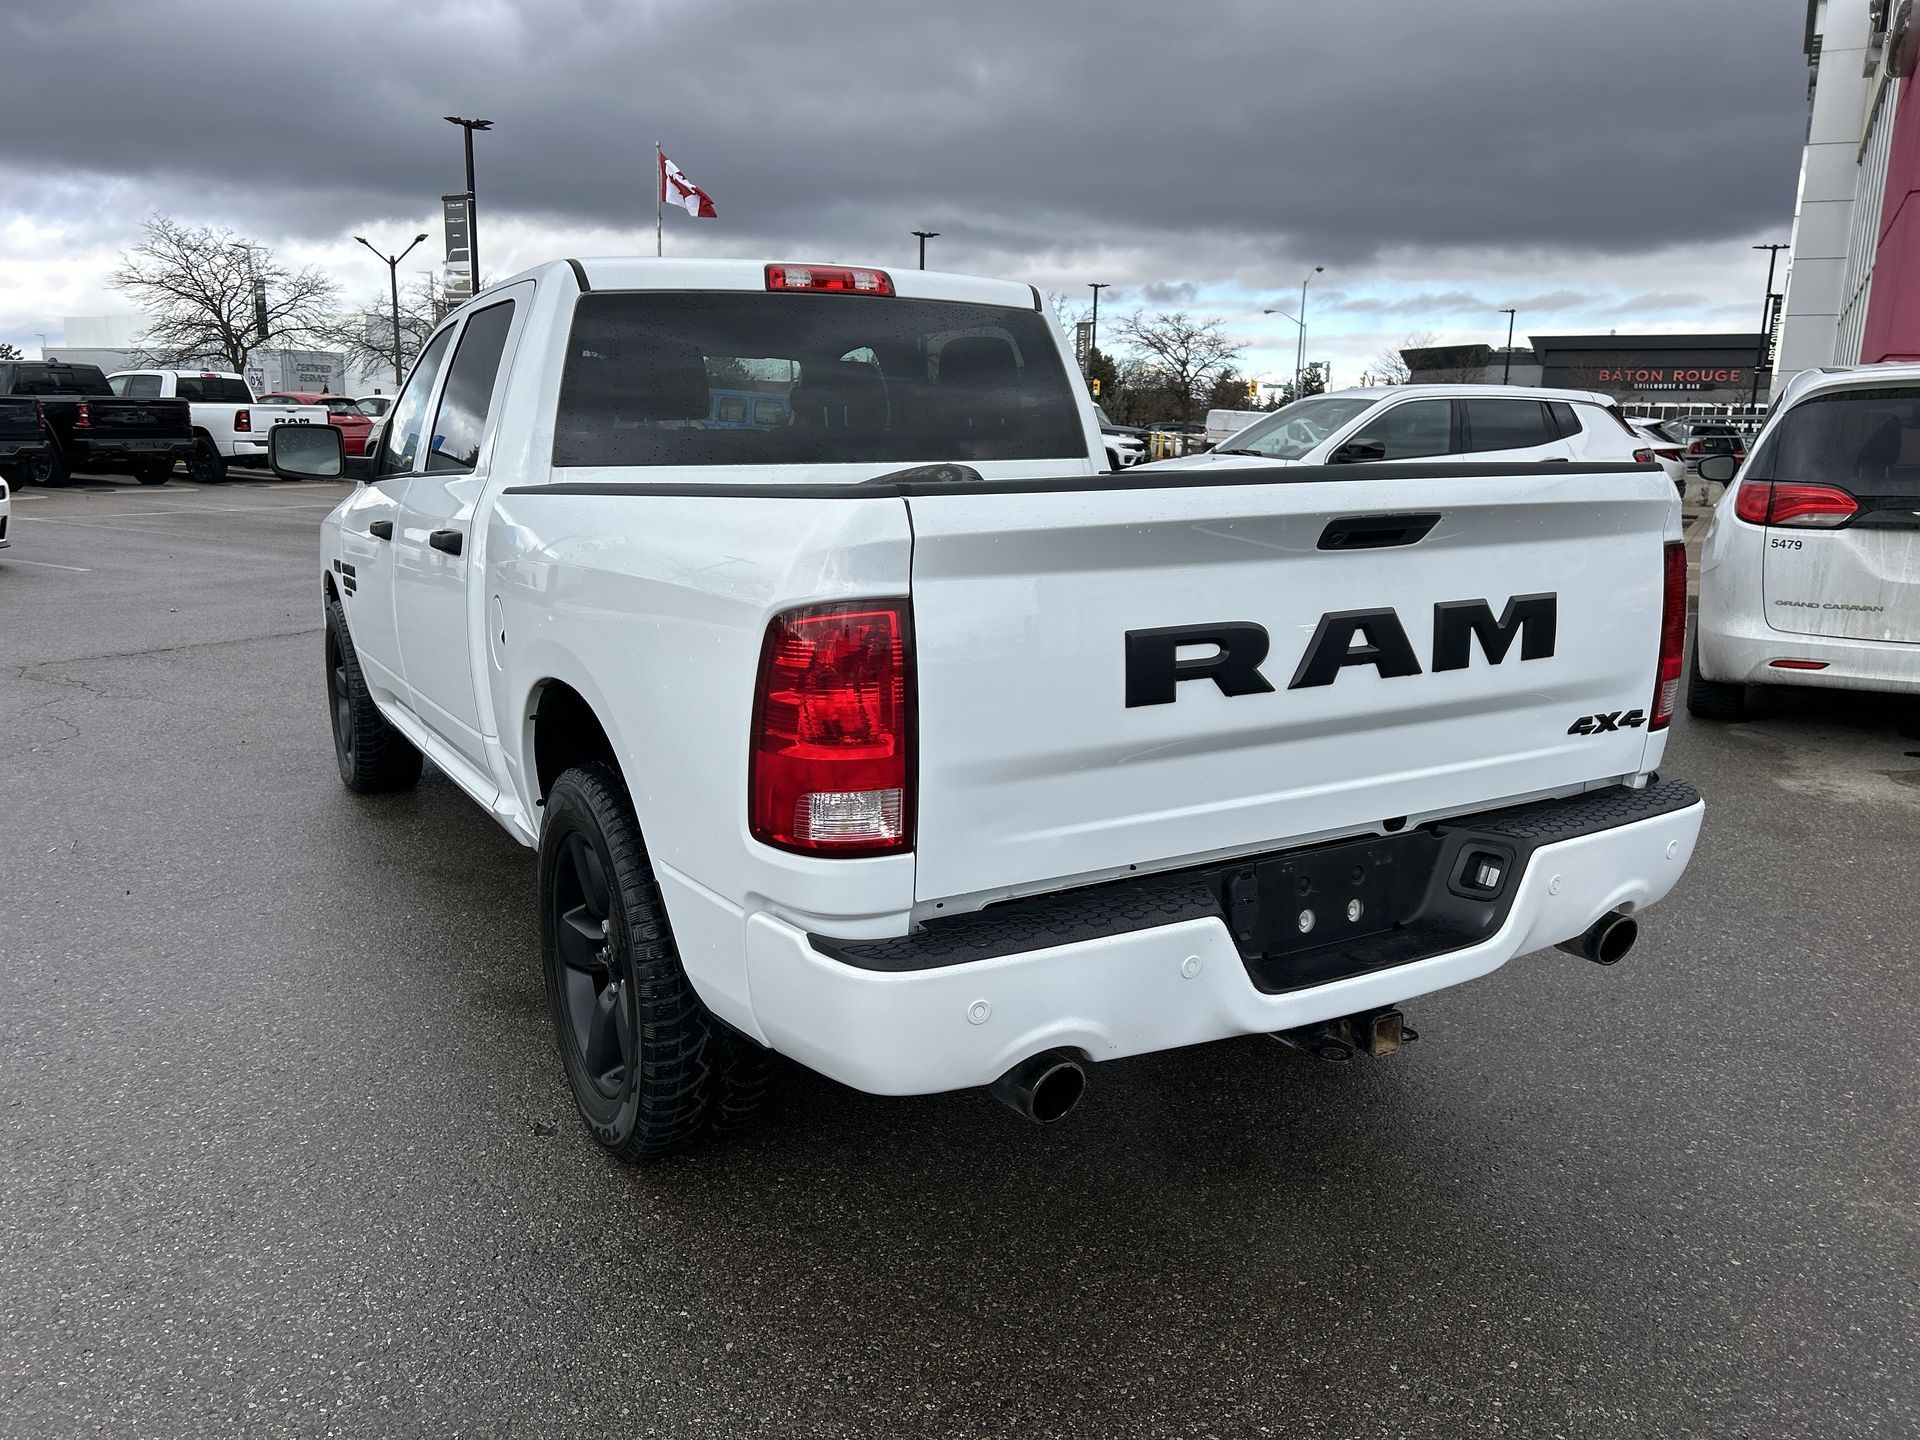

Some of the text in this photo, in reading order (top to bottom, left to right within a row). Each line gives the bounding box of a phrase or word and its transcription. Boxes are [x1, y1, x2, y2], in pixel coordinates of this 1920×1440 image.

[296, 363, 332, 373] CERTIFIED
[299, 373, 330, 383] SERVICE
[1673, 369, 1741, 382] ROUGE
[1770, 538, 1803, 551] 5479
[1775, 600, 1884, 613] GRAND CARAVAN
[1124, 591, 1558, 709] RAM
